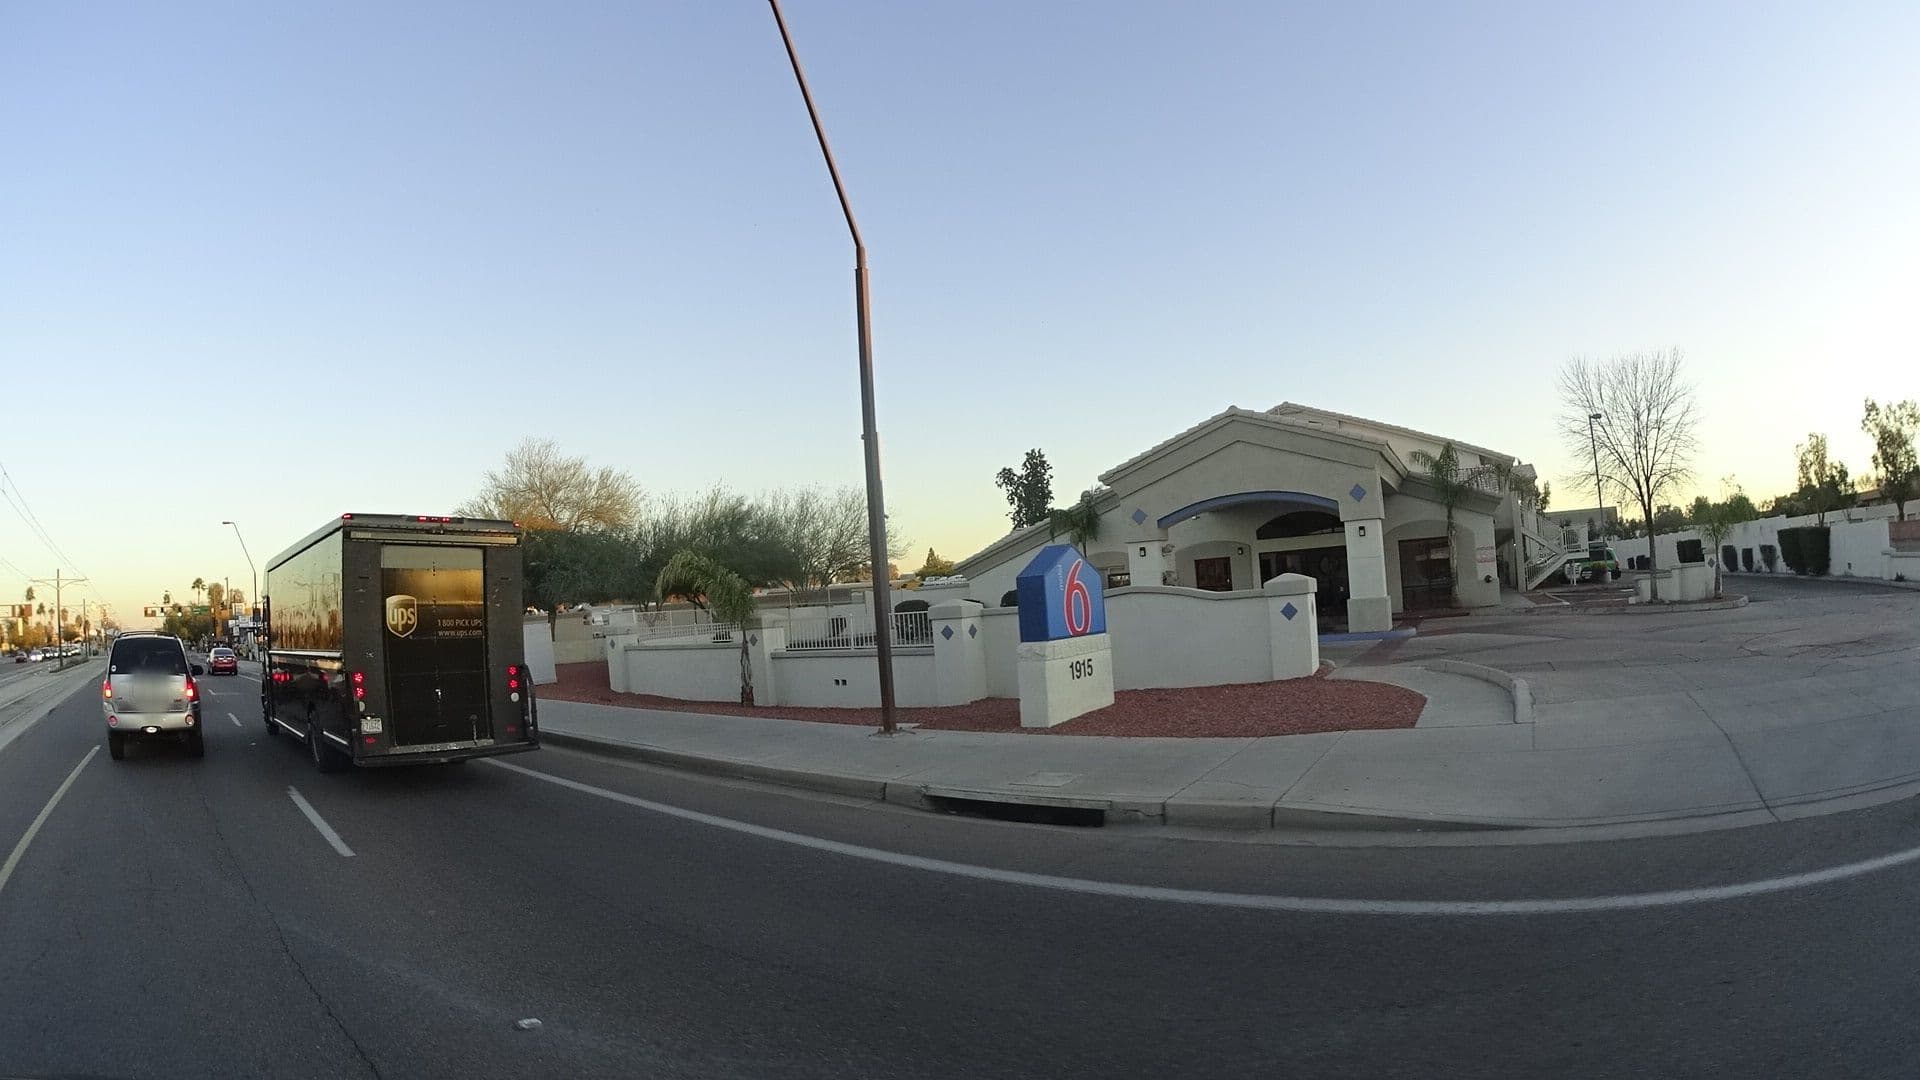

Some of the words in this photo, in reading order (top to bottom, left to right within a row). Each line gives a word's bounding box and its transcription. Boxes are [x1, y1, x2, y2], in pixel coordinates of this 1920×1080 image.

[1064, 558, 1091, 637] 6
[389, 607, 415, 631] ups
[455, 619, 470, 627] PICK
[470, 618, 483, 627] UPS
[438, 629, 482, 637] www.ups.com
[1069, 658, 1093, 680] 1915
